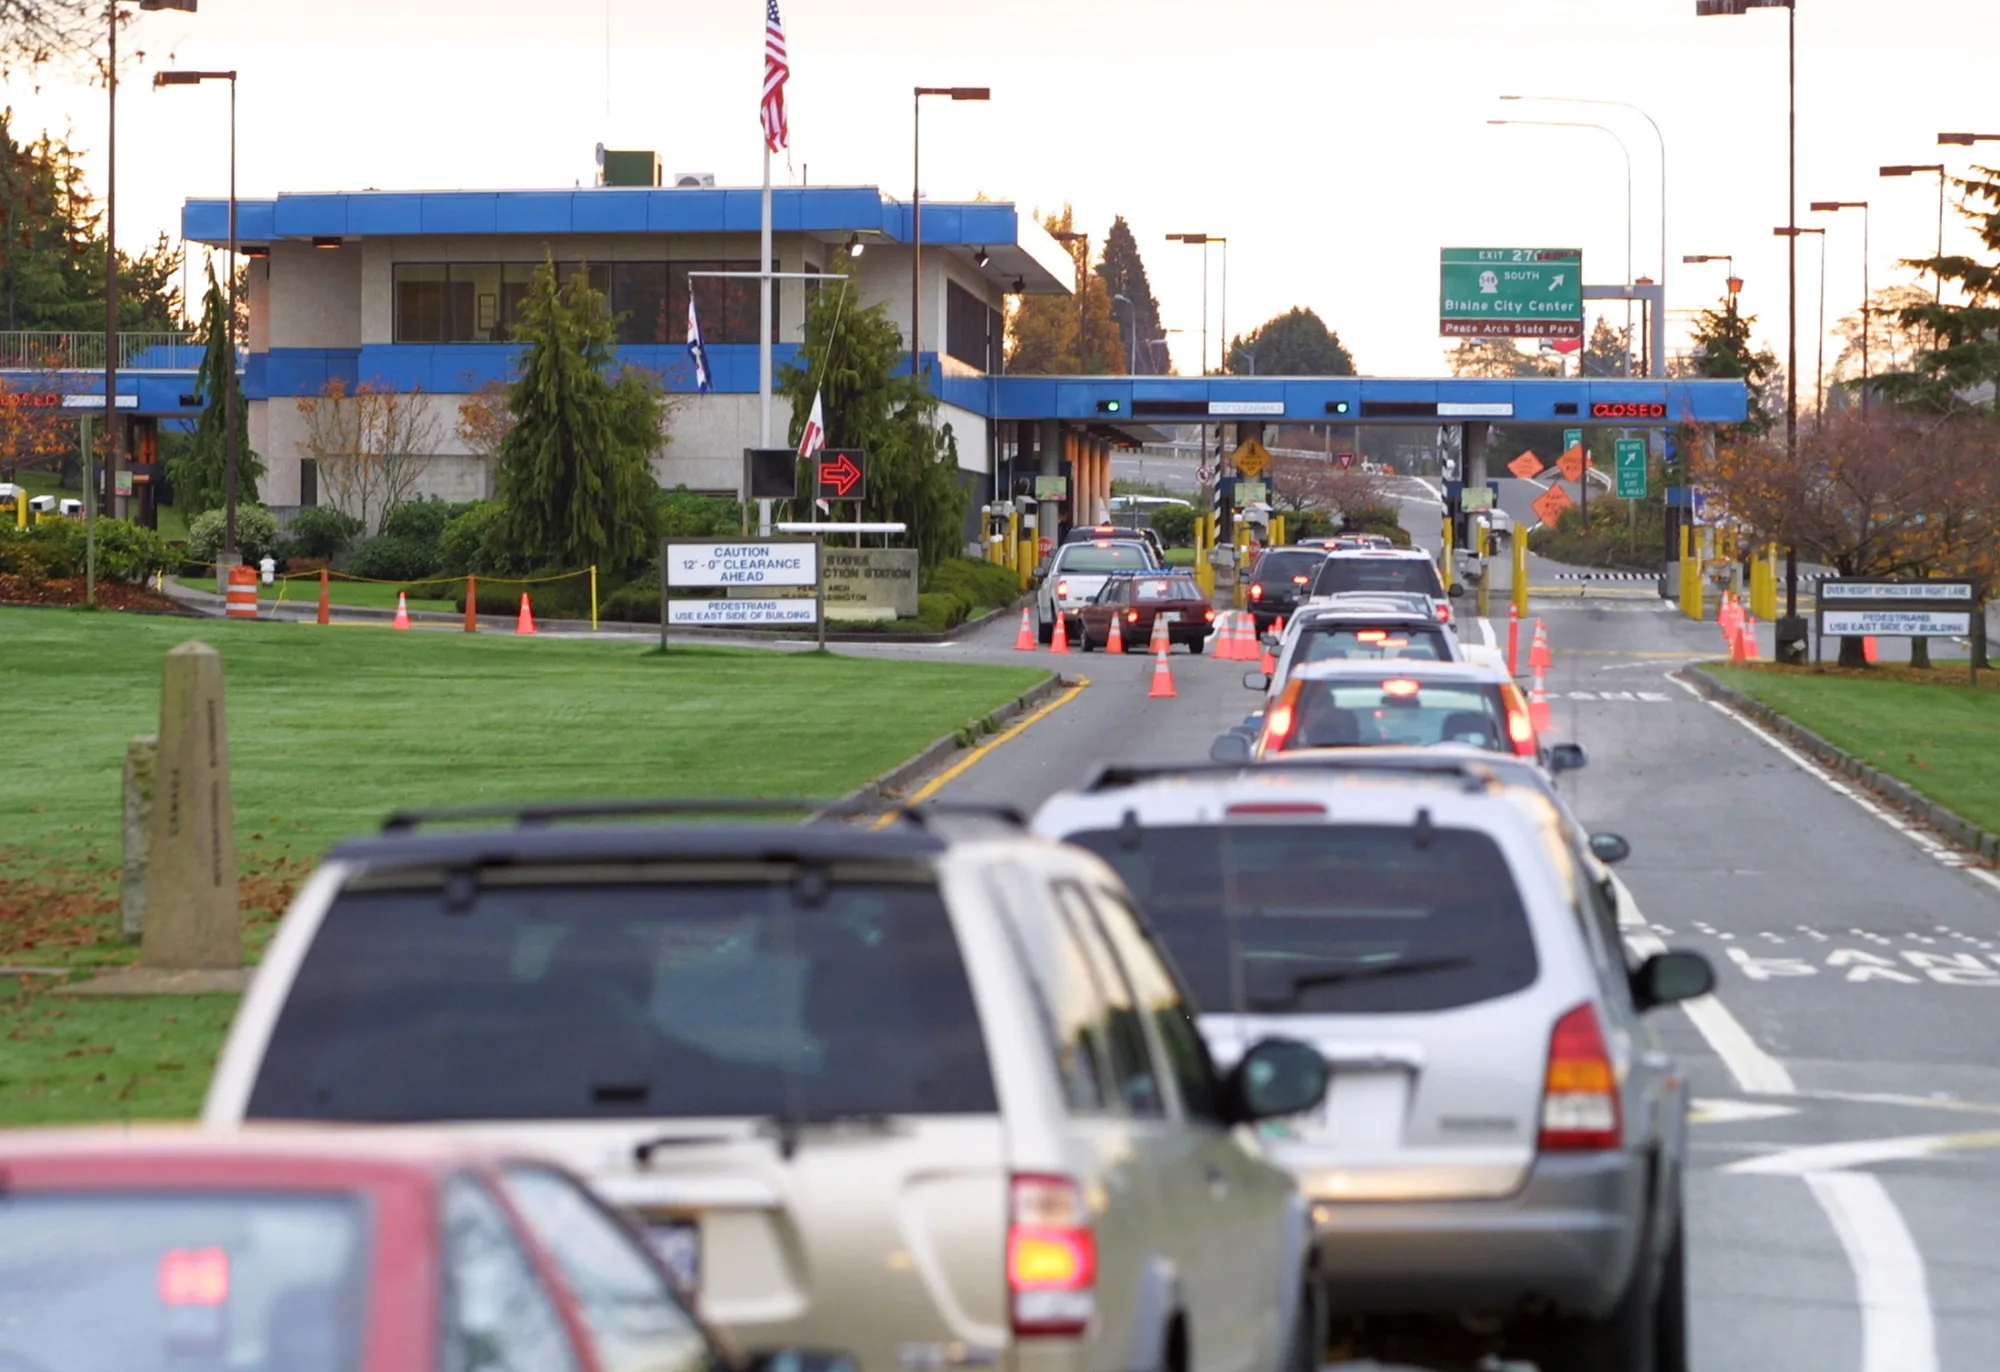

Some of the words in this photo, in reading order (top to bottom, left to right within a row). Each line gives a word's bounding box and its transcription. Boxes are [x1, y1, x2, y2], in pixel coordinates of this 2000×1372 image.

[1479, 251, 1503, 260] EXIT
[1504, 271, 1540, 280] SOUTH
[1445, 299, 1488, 311] Blaine
[1494, 299, 1523, 313] City
[1529, 300, 1574, 311] Center
[1445, 323, 1478, 333] Peace
[1483, 323, 1510, 333] Arch
[1515, 323, 1544, 334] State
[1549, 324, 1575, 334] Park
[1593, 402, 1662, 417] CLOSED
[714, 547, 769, 557] CAUTION
[683, 559, 698, 570] 12'
[724, 559, 800, 569] CLEARANCE
[826, 555, 869, 565] STATES
[720, 571, 764, 581] AHEAD
[823, 568, 859, 578] CTION
[864, 568, 911, 578] STATION
[708, 602, 777, 610] PEDESTRIANS
[675, 612, 693, 620] USE
[697, 612, 722, 620] EAST
[726, 611, 747, 620] SIDE
[750, 611, 763, 619] OF
[765, 611, 810, 619] BUILDING
[1863, 613, 1930, 621] PEDESTRIANS
[1829, 623, 1848, 631] USE
[1851, 623, 1876, 631] EAST
[1880, 623, 1900, 631] SIDE
[1903, 623, 1916, 631] OF
[1919, 623, 1964, 632] BUILDING
